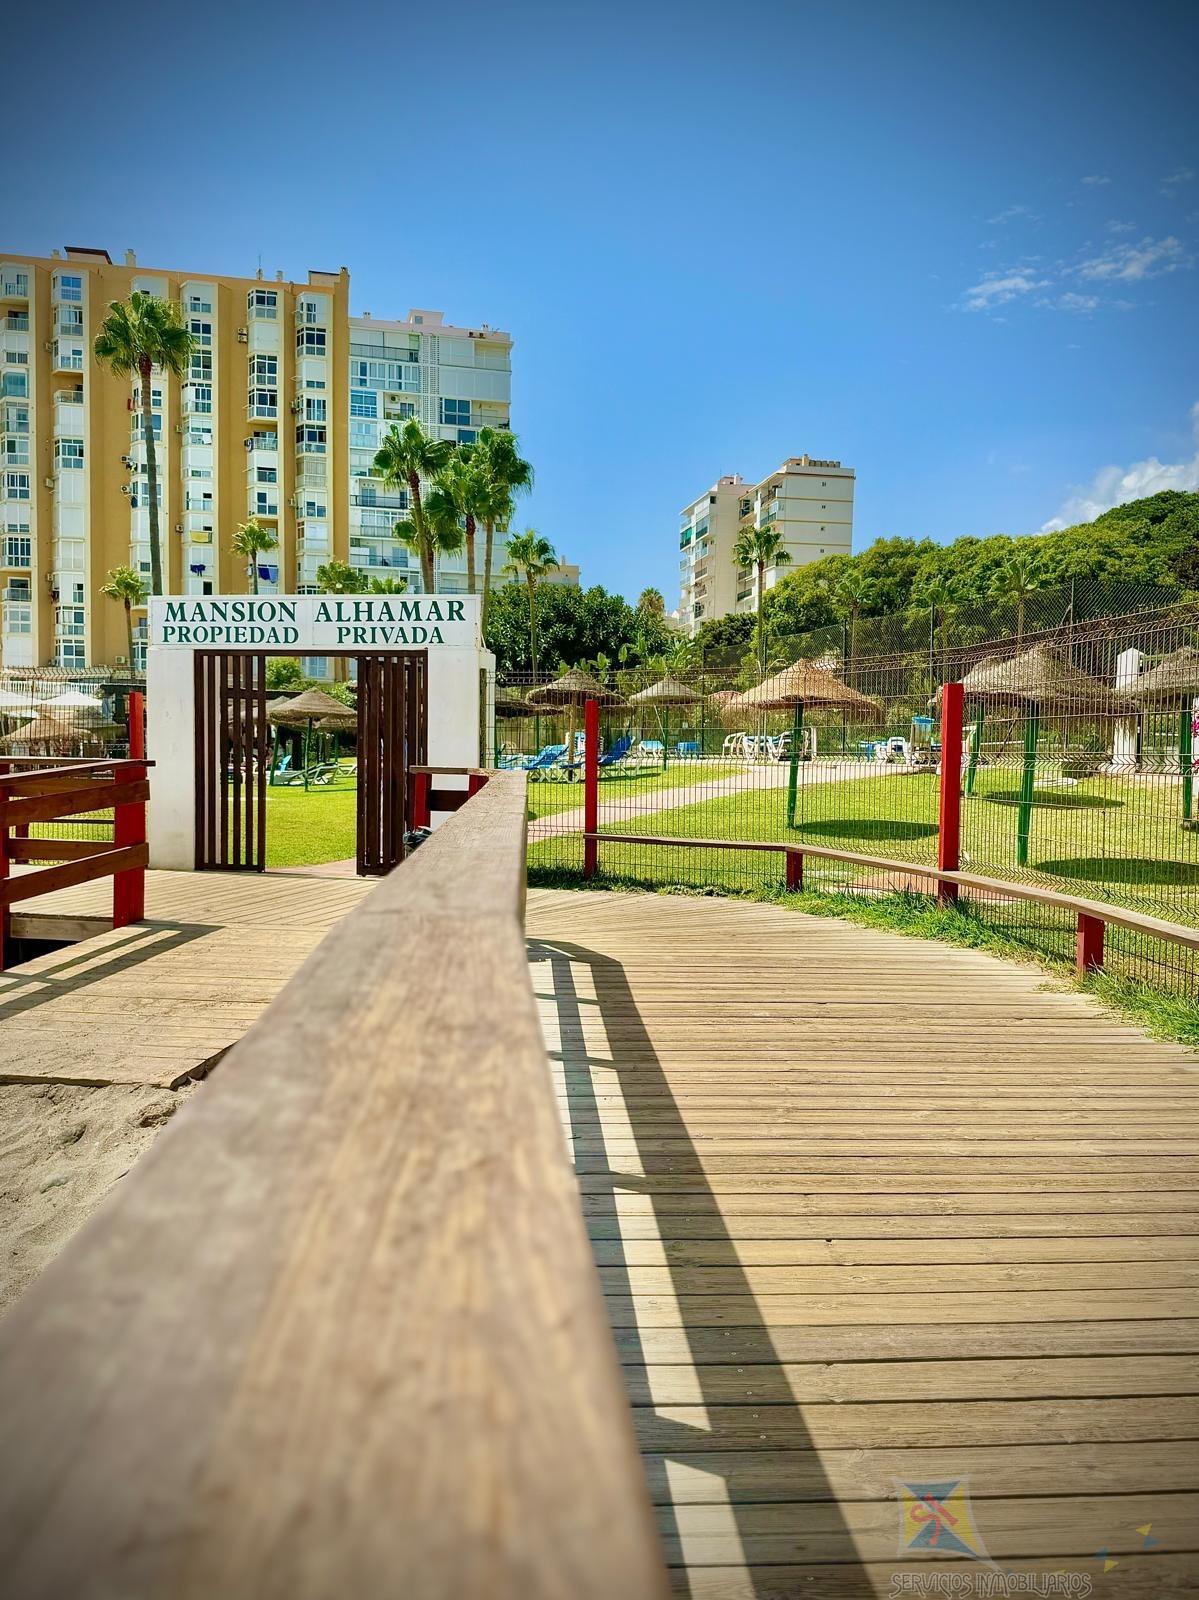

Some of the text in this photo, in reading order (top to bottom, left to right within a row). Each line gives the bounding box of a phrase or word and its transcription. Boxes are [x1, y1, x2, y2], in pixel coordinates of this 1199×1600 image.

[164, 600, 466, 623] MANSION ALHAMAR
[162, 626, 445, 645] PROPIEDAD PRIVADA
